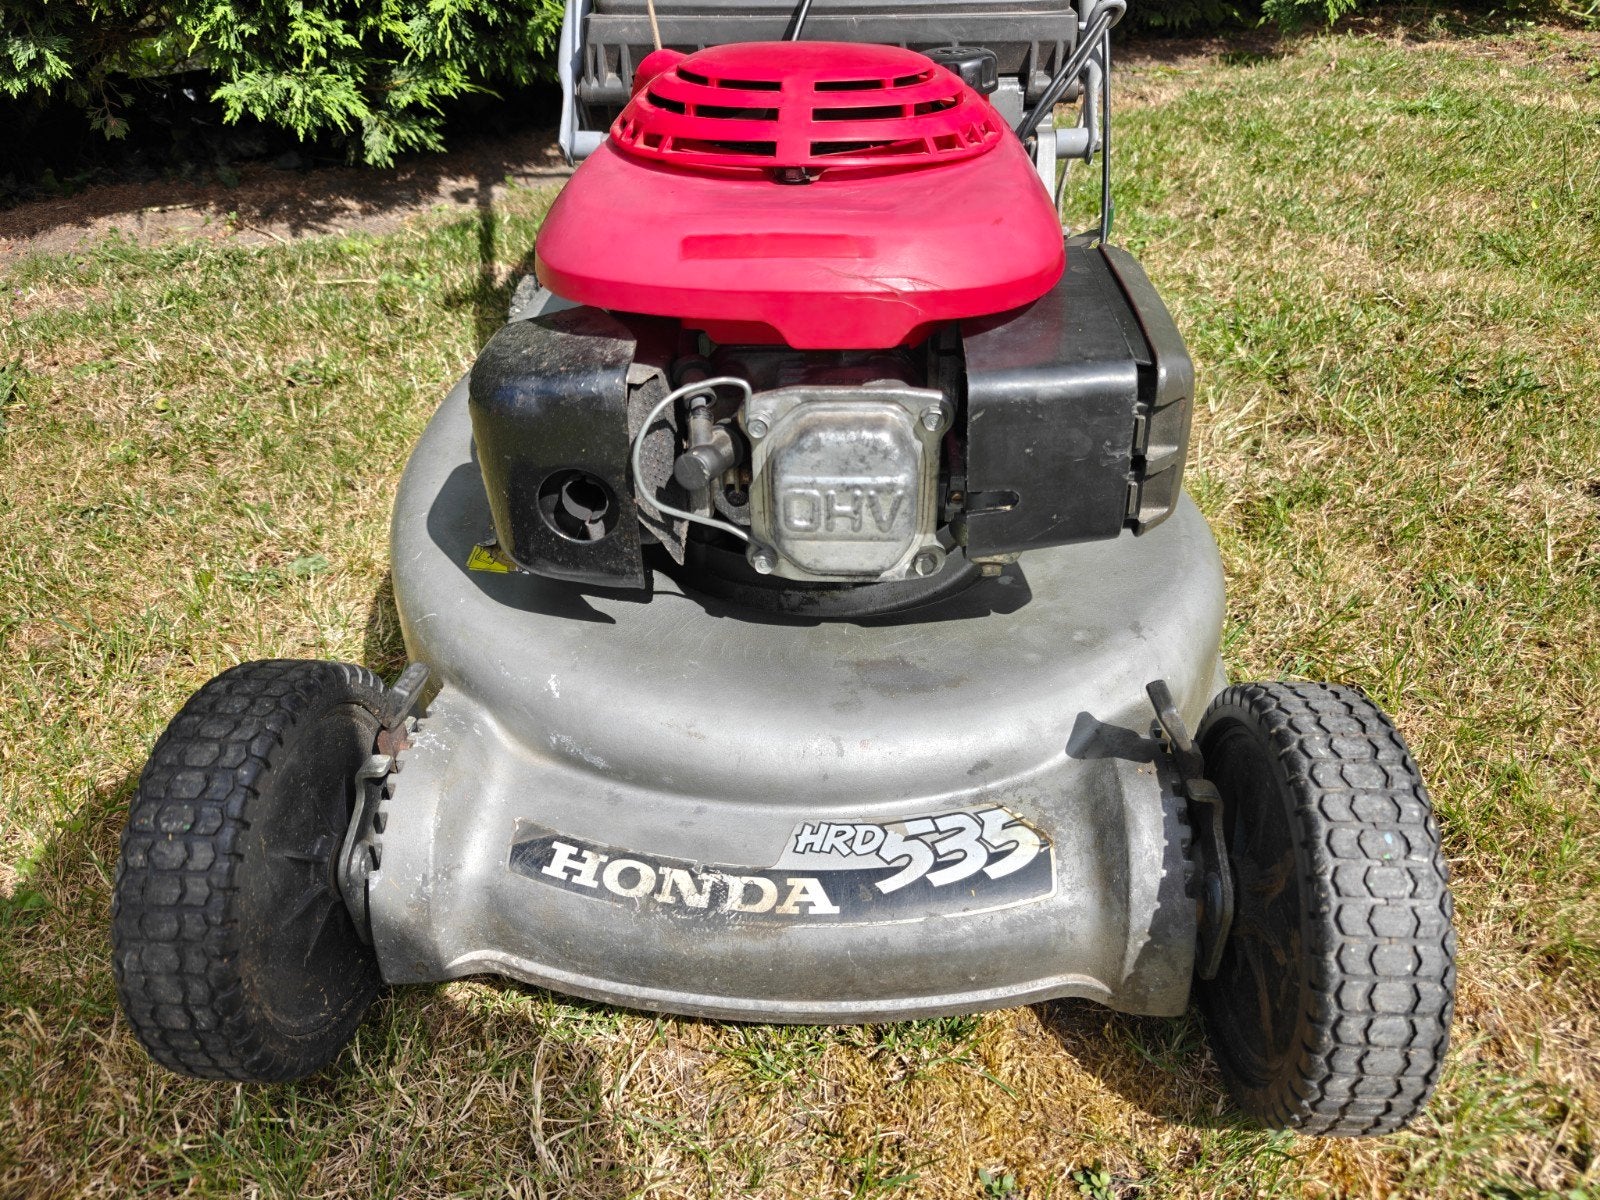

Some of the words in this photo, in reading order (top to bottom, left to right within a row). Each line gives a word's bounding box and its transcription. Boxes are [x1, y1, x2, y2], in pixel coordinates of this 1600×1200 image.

[784, 489, 905, 533] OHV
[541, 841, 839, 915] HONDA
[793, 821, 883, 858] HRD
[876, 806, 1043, 894] 535
